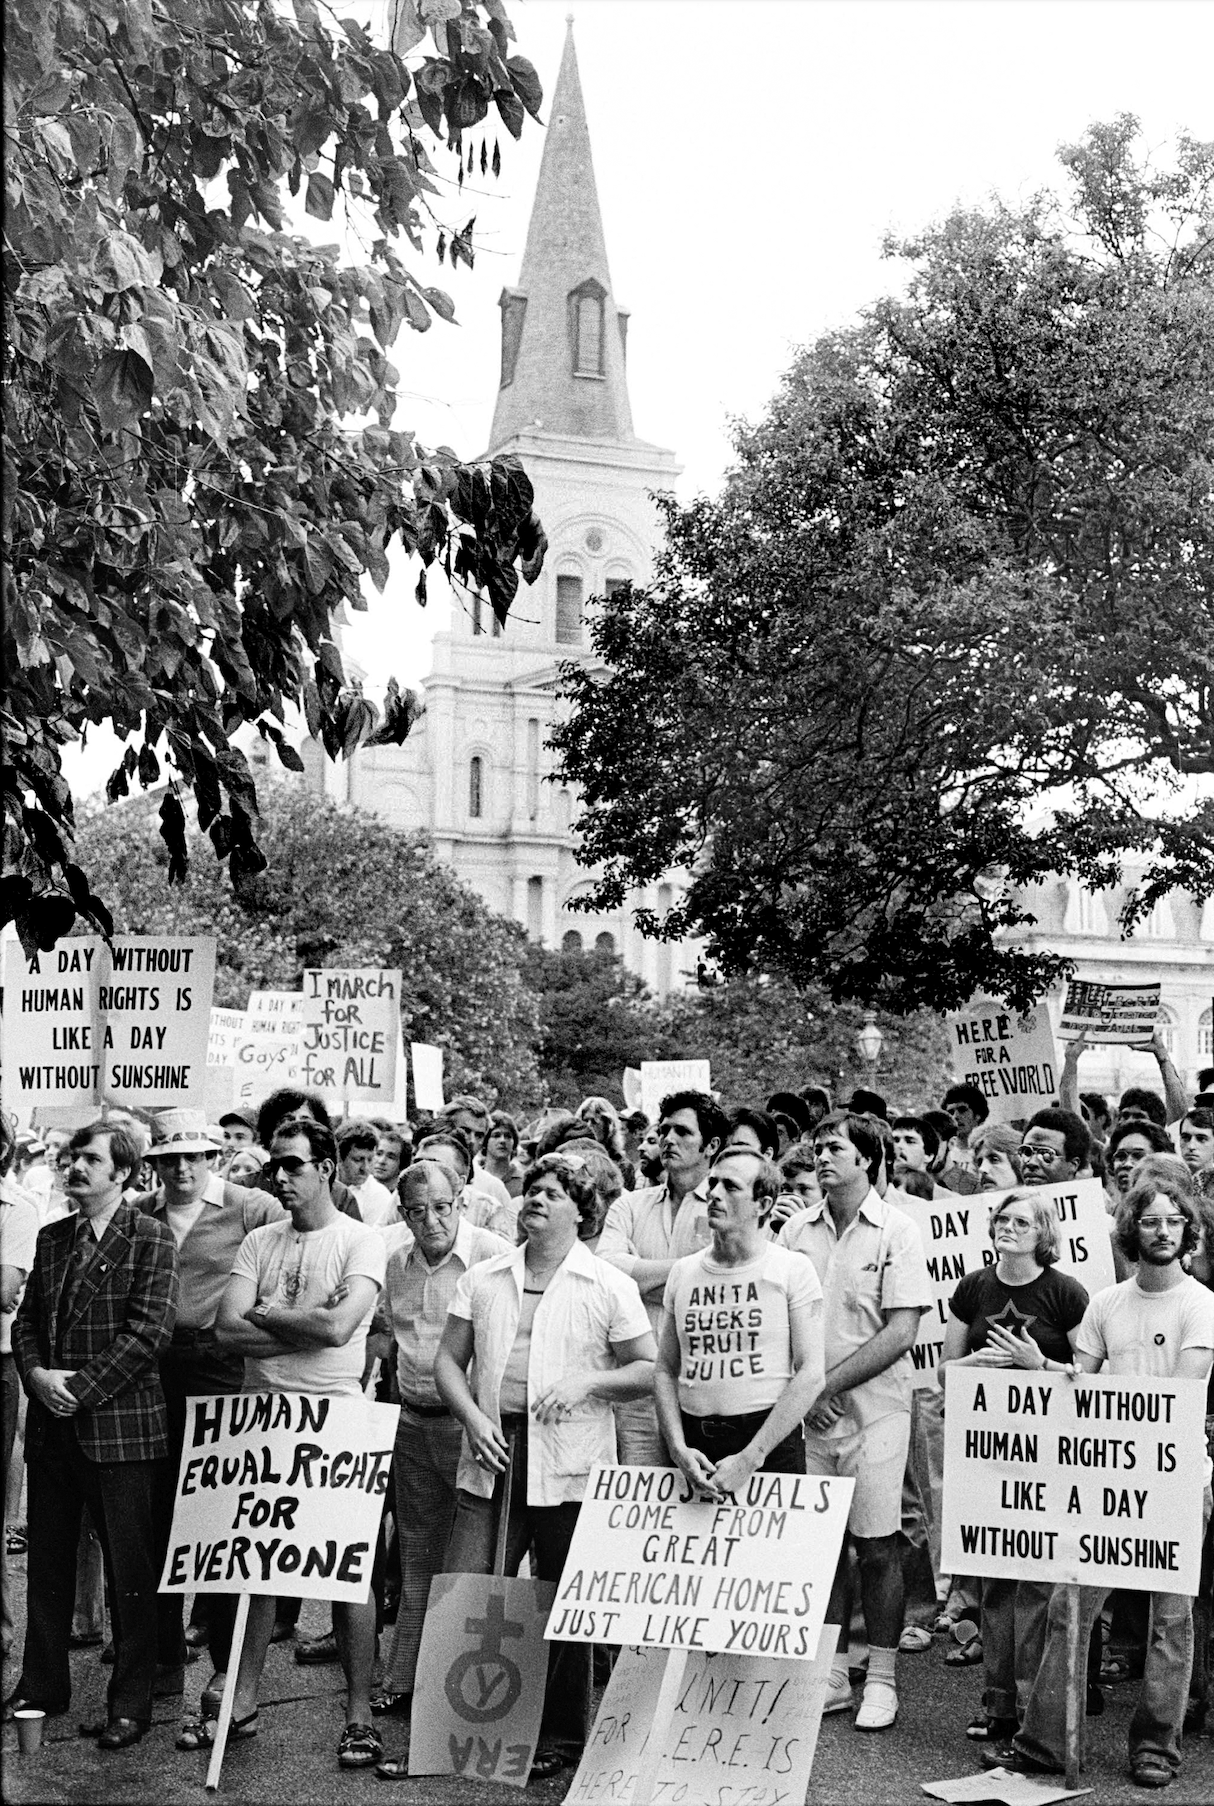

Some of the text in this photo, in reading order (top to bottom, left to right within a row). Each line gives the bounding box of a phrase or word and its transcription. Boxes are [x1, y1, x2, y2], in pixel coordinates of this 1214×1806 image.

[28, 948, 193, 974] A DAY WITHOUT
[22, 987, 192, 1012] HUMAN RIGHTS IS
[308, 972, 323, 999] I
[269, 999, 285, 1012] DAY
[52, 1025, 167, 1050] LIKE A DAY
[303, 1023, 385, 1053] JUSTICE
[208, 1052, 228, 1065] DAY
[239, 1044, 287, 1072] Gays
[975, 1045, 1011, 1064] FOR A
[19, 1065, 191, 1089] WITHOUT SUNSHINE
[343, 1057, 381, 1088] ALL
[965, 1063, 1055, 1097] FREE WORLD
[930, 1209, 970, 1240] DAY
[1069, 1237, 1089, 1263] IS
[689, 1282, 759, 1307] ANITA
[684, 1308, 762, 1333] SUCKS
[689, 1331, 760, 1357] FRUIT
[686, 1353, 764, 1381] JUICE
[973, 1383, 1176, 1423] A DAY WITHOUT
[192, 1393, 330, 1447] HUMAN
[965, 1429, 1177, 1472] HUMAN RIGHTS IS
[181, 1445, 281, 1496] EQUAL
[231, 1491, 300, 1531] FOR
[1001, 1480, 1148, 1519] LIKE A DAY
[607, 1504, 788, 1540] COME FROM
[167, 1536, 369, 1586] EVERYONE
[642, 1534, 741, 1567] GREAT
[960, 1524, 1180, 1571] WITHOUT SUNSHINE
[561, 1570, 813, 1617] AMERICAN HOMES
[553, 1609, 809, 1656] JUST LIKE YOURS
[448, 1733, 532, 1778] ERA
[591, 1712, 631, 1746] FOR
[762, 1736, 800, 1774] IS
[573, 1769, 639, 1801] HERE
[651, 1781, 689, 1804] TO
